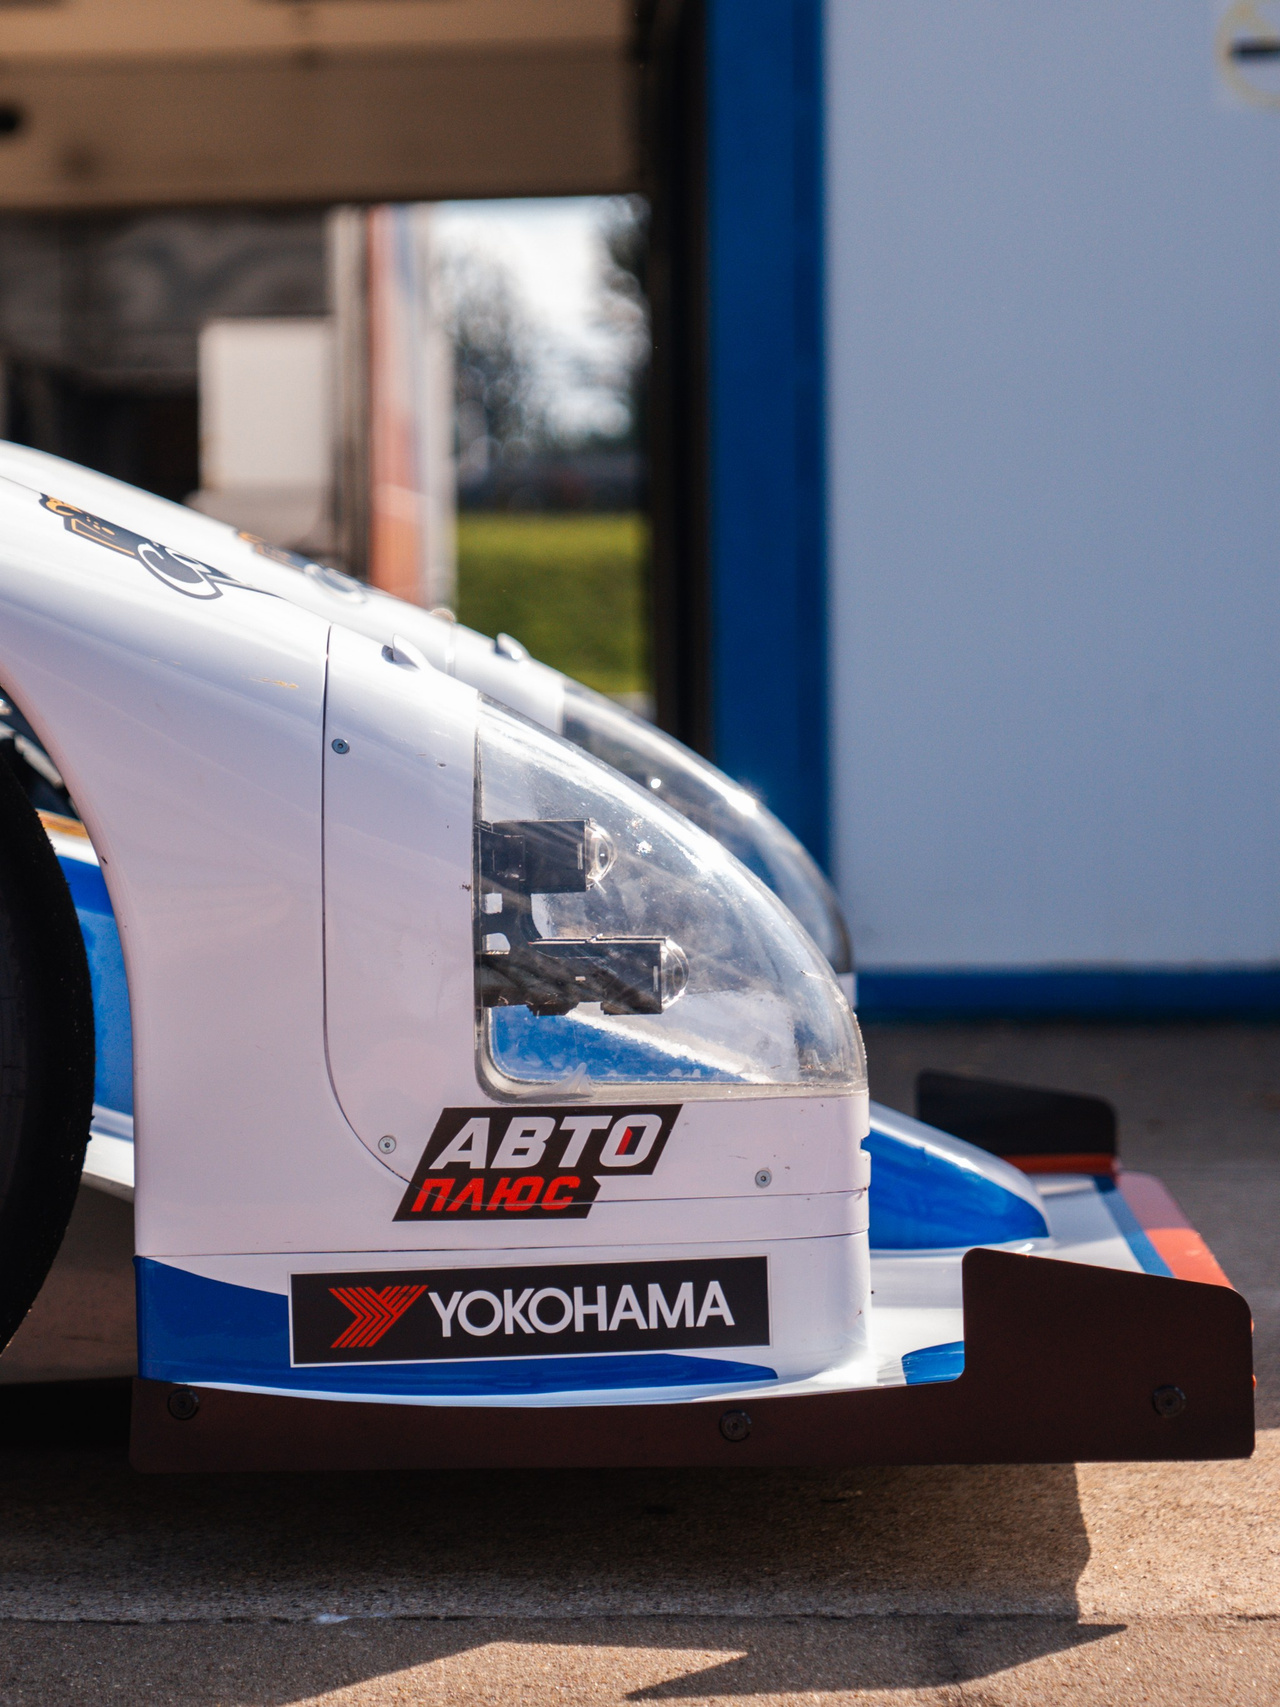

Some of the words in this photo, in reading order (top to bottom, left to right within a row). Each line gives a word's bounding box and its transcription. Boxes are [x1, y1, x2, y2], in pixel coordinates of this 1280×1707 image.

[428, 1114, 663, 1170] АВТО
[410, 1176, 581, 1212] ПЛЮС
[428, 1280, 735, 1338] YOKOHAMA
